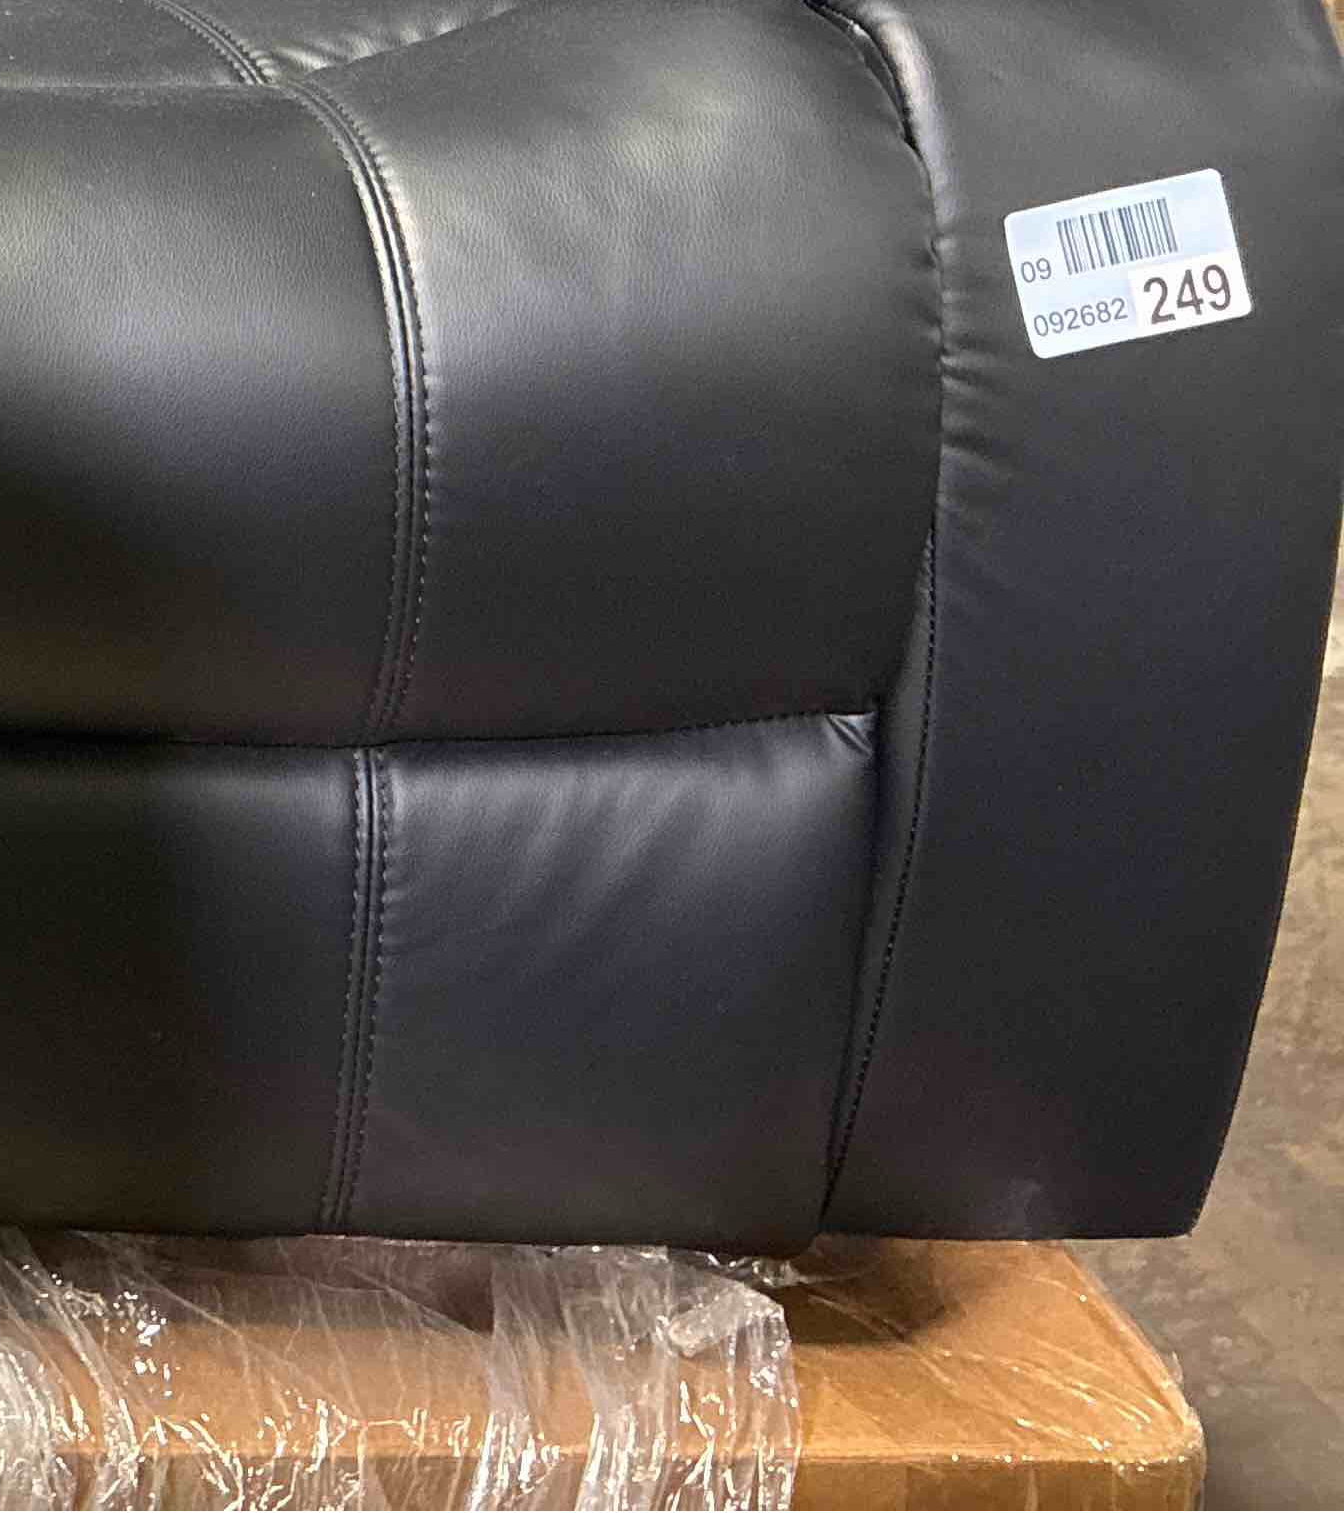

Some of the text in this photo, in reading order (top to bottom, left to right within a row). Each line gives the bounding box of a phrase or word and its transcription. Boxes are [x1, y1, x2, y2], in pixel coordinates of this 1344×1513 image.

[1020, 257, 1052, 284] 09
[1033, 264, 1232, 337] 092682 249
